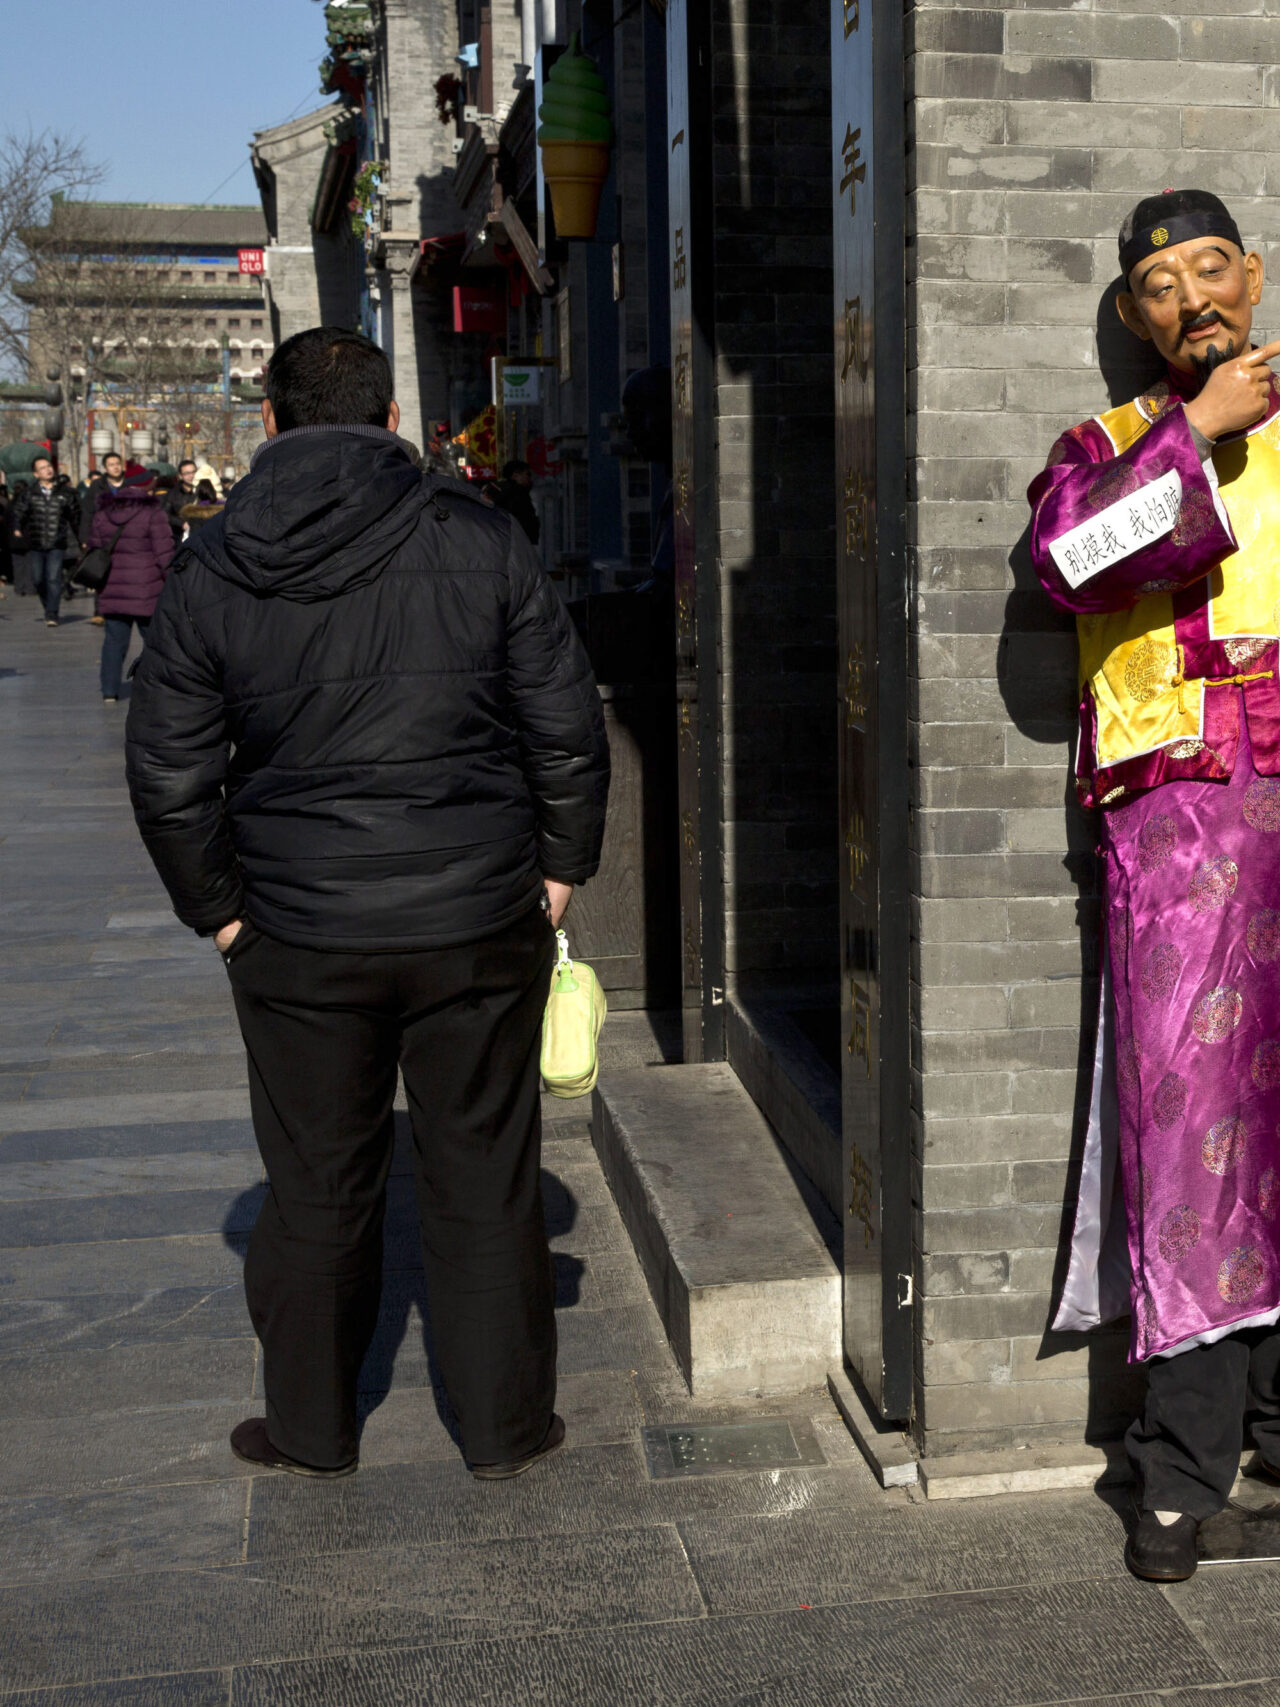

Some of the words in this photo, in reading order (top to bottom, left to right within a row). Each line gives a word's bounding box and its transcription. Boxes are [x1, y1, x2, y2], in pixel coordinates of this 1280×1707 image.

[240, 252, 260, 261] UNI
[241, 262, 262, 272] QLO
[1064, 523, 1127, 576] 别摸我
[1128, 486, 1180, 540] 我怕脏
